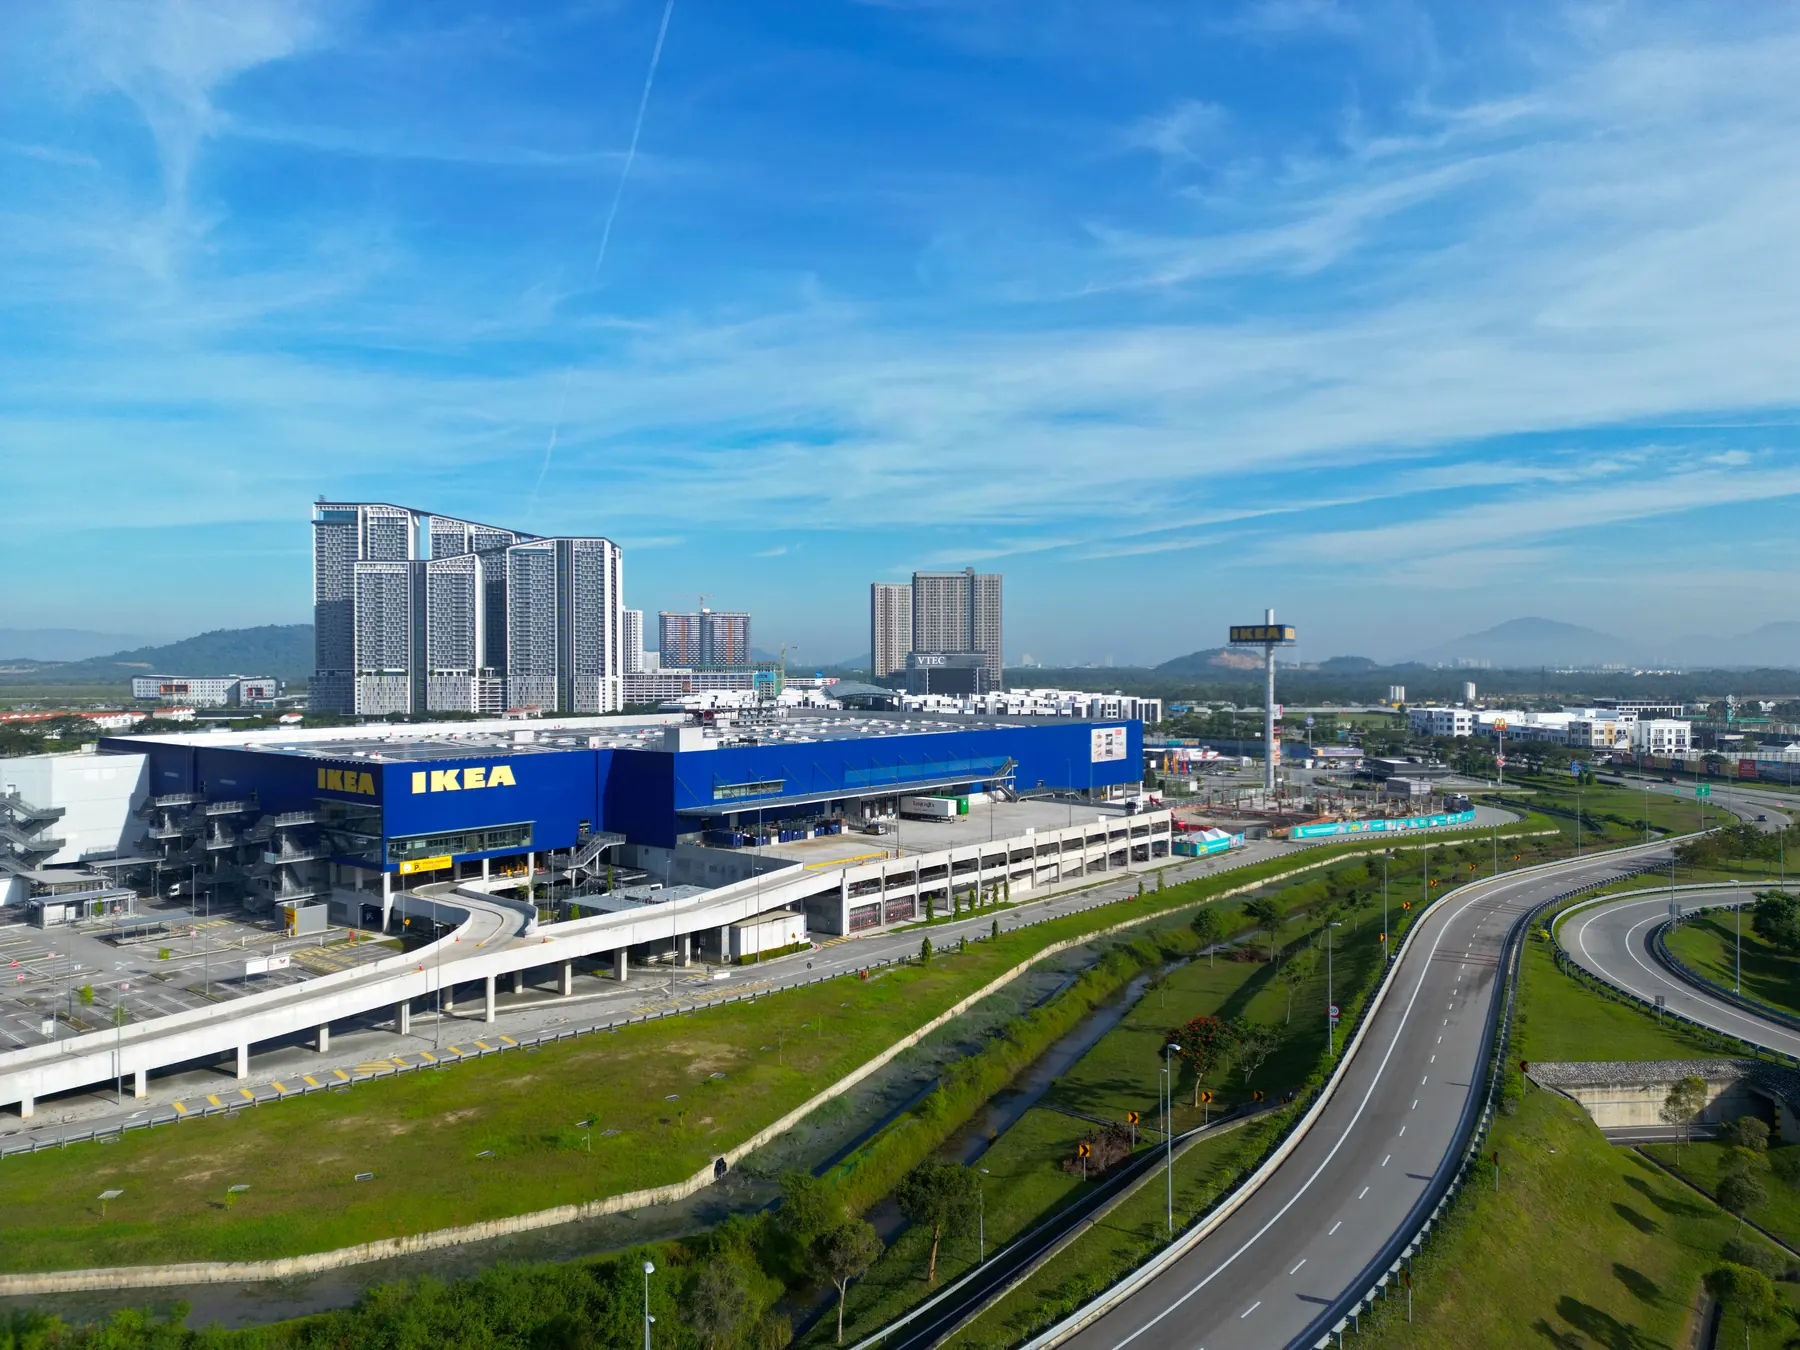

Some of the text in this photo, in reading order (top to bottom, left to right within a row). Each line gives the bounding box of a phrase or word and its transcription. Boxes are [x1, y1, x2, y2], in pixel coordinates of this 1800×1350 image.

[1232, 627, 1280, 639] IKEA
[918, 656, 945, 665] VTEC
[317, 768, 375, 795] IKEA
[412, 765, 516, 794] IKEA
